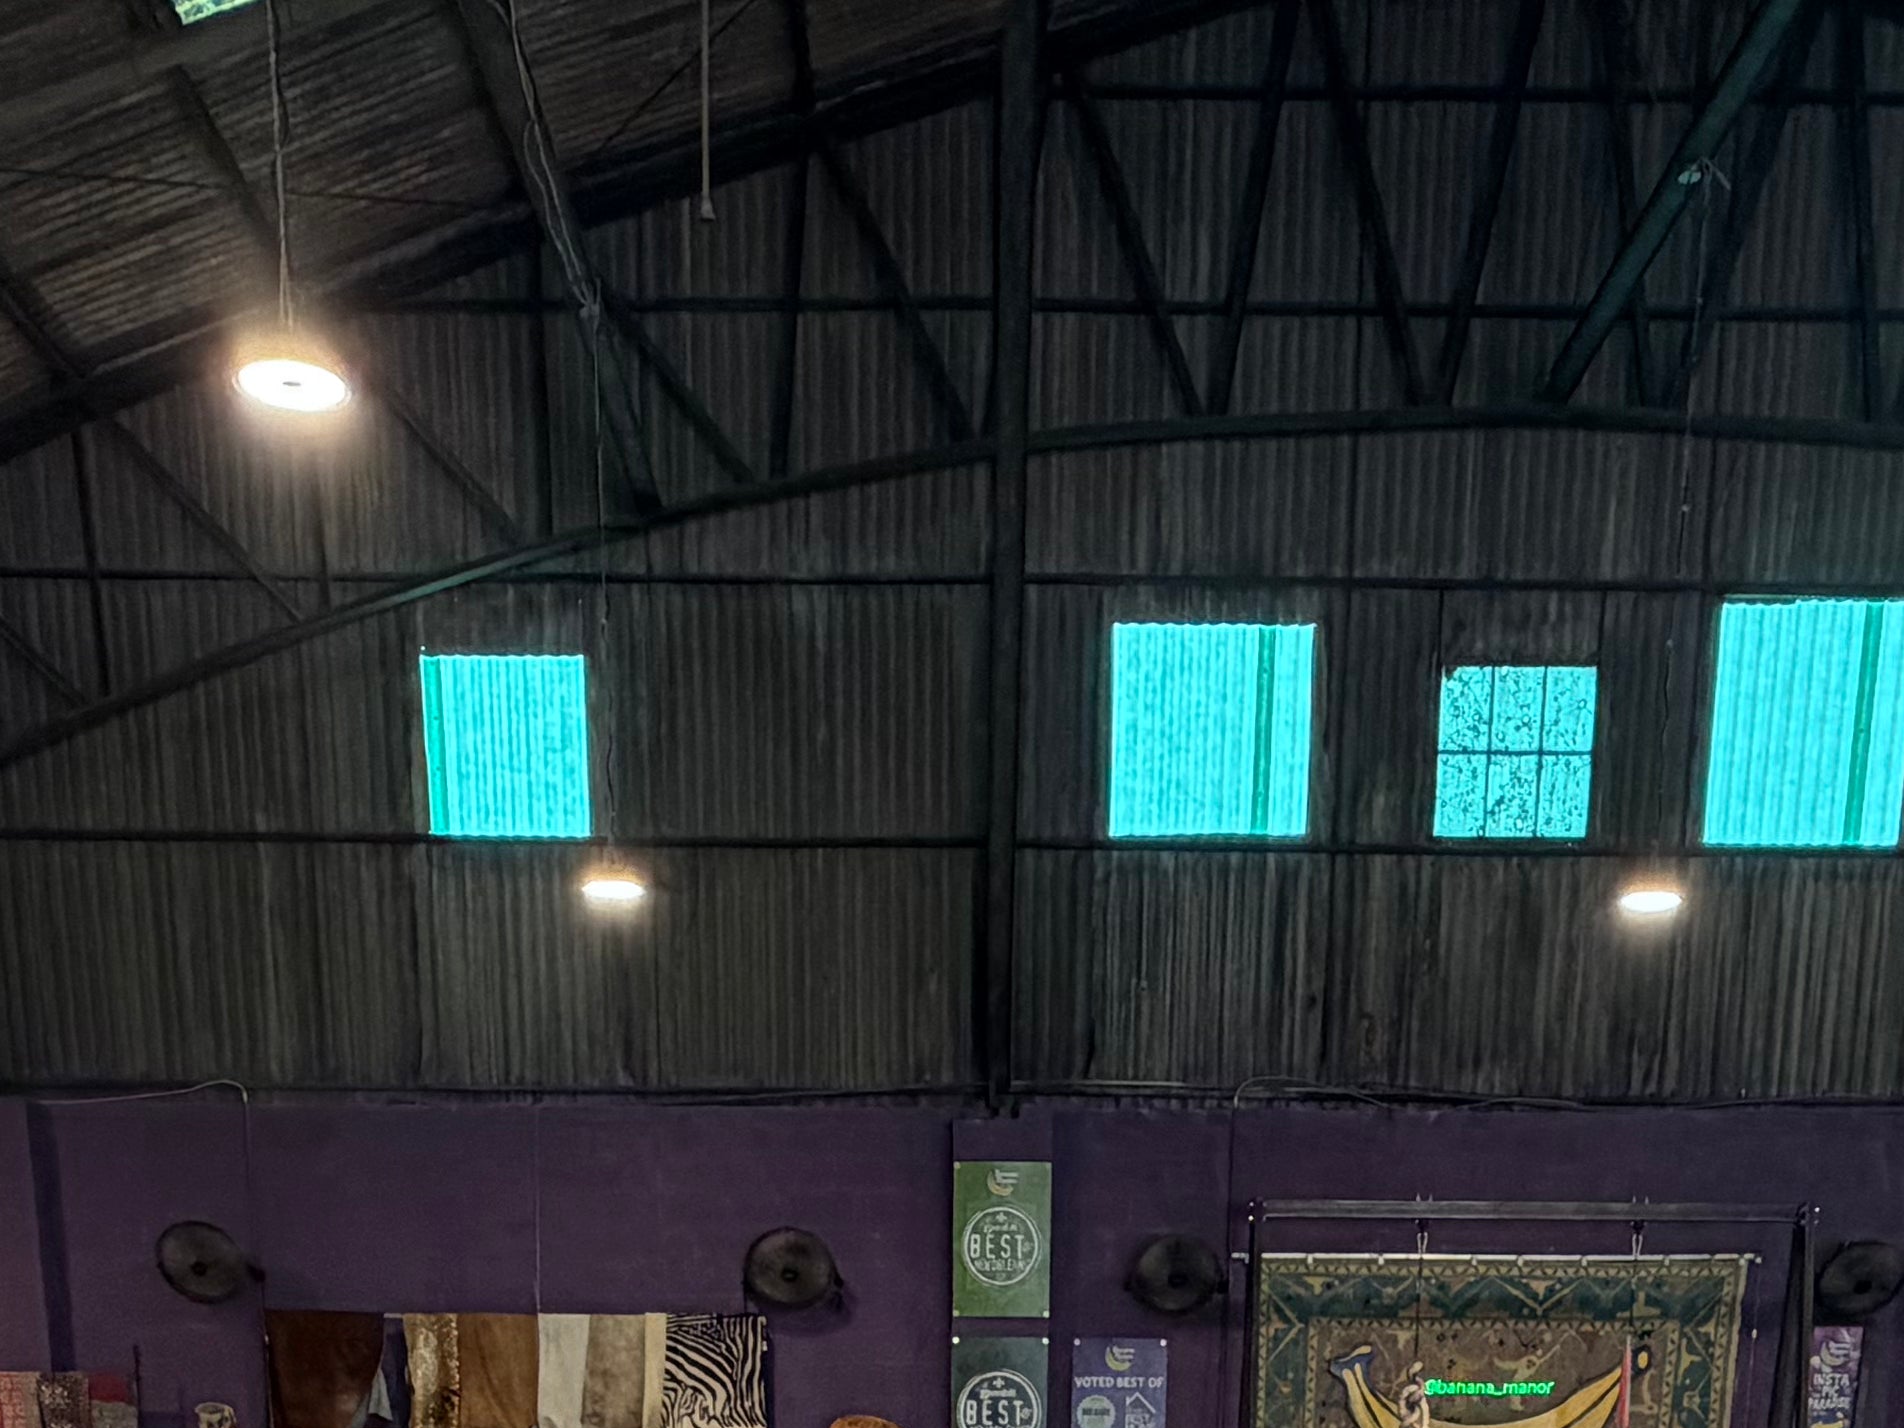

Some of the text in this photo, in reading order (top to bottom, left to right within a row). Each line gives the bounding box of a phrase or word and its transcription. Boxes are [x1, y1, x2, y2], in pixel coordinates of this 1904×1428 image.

[970, 1233, 1024, 1259] BEST
[1074, 1376, 1165, 1389] VOTED BEST OF
[1424, 1378, 1555, 1396] @banana_manor
[966, 1400, 1024, 1425] BEST
